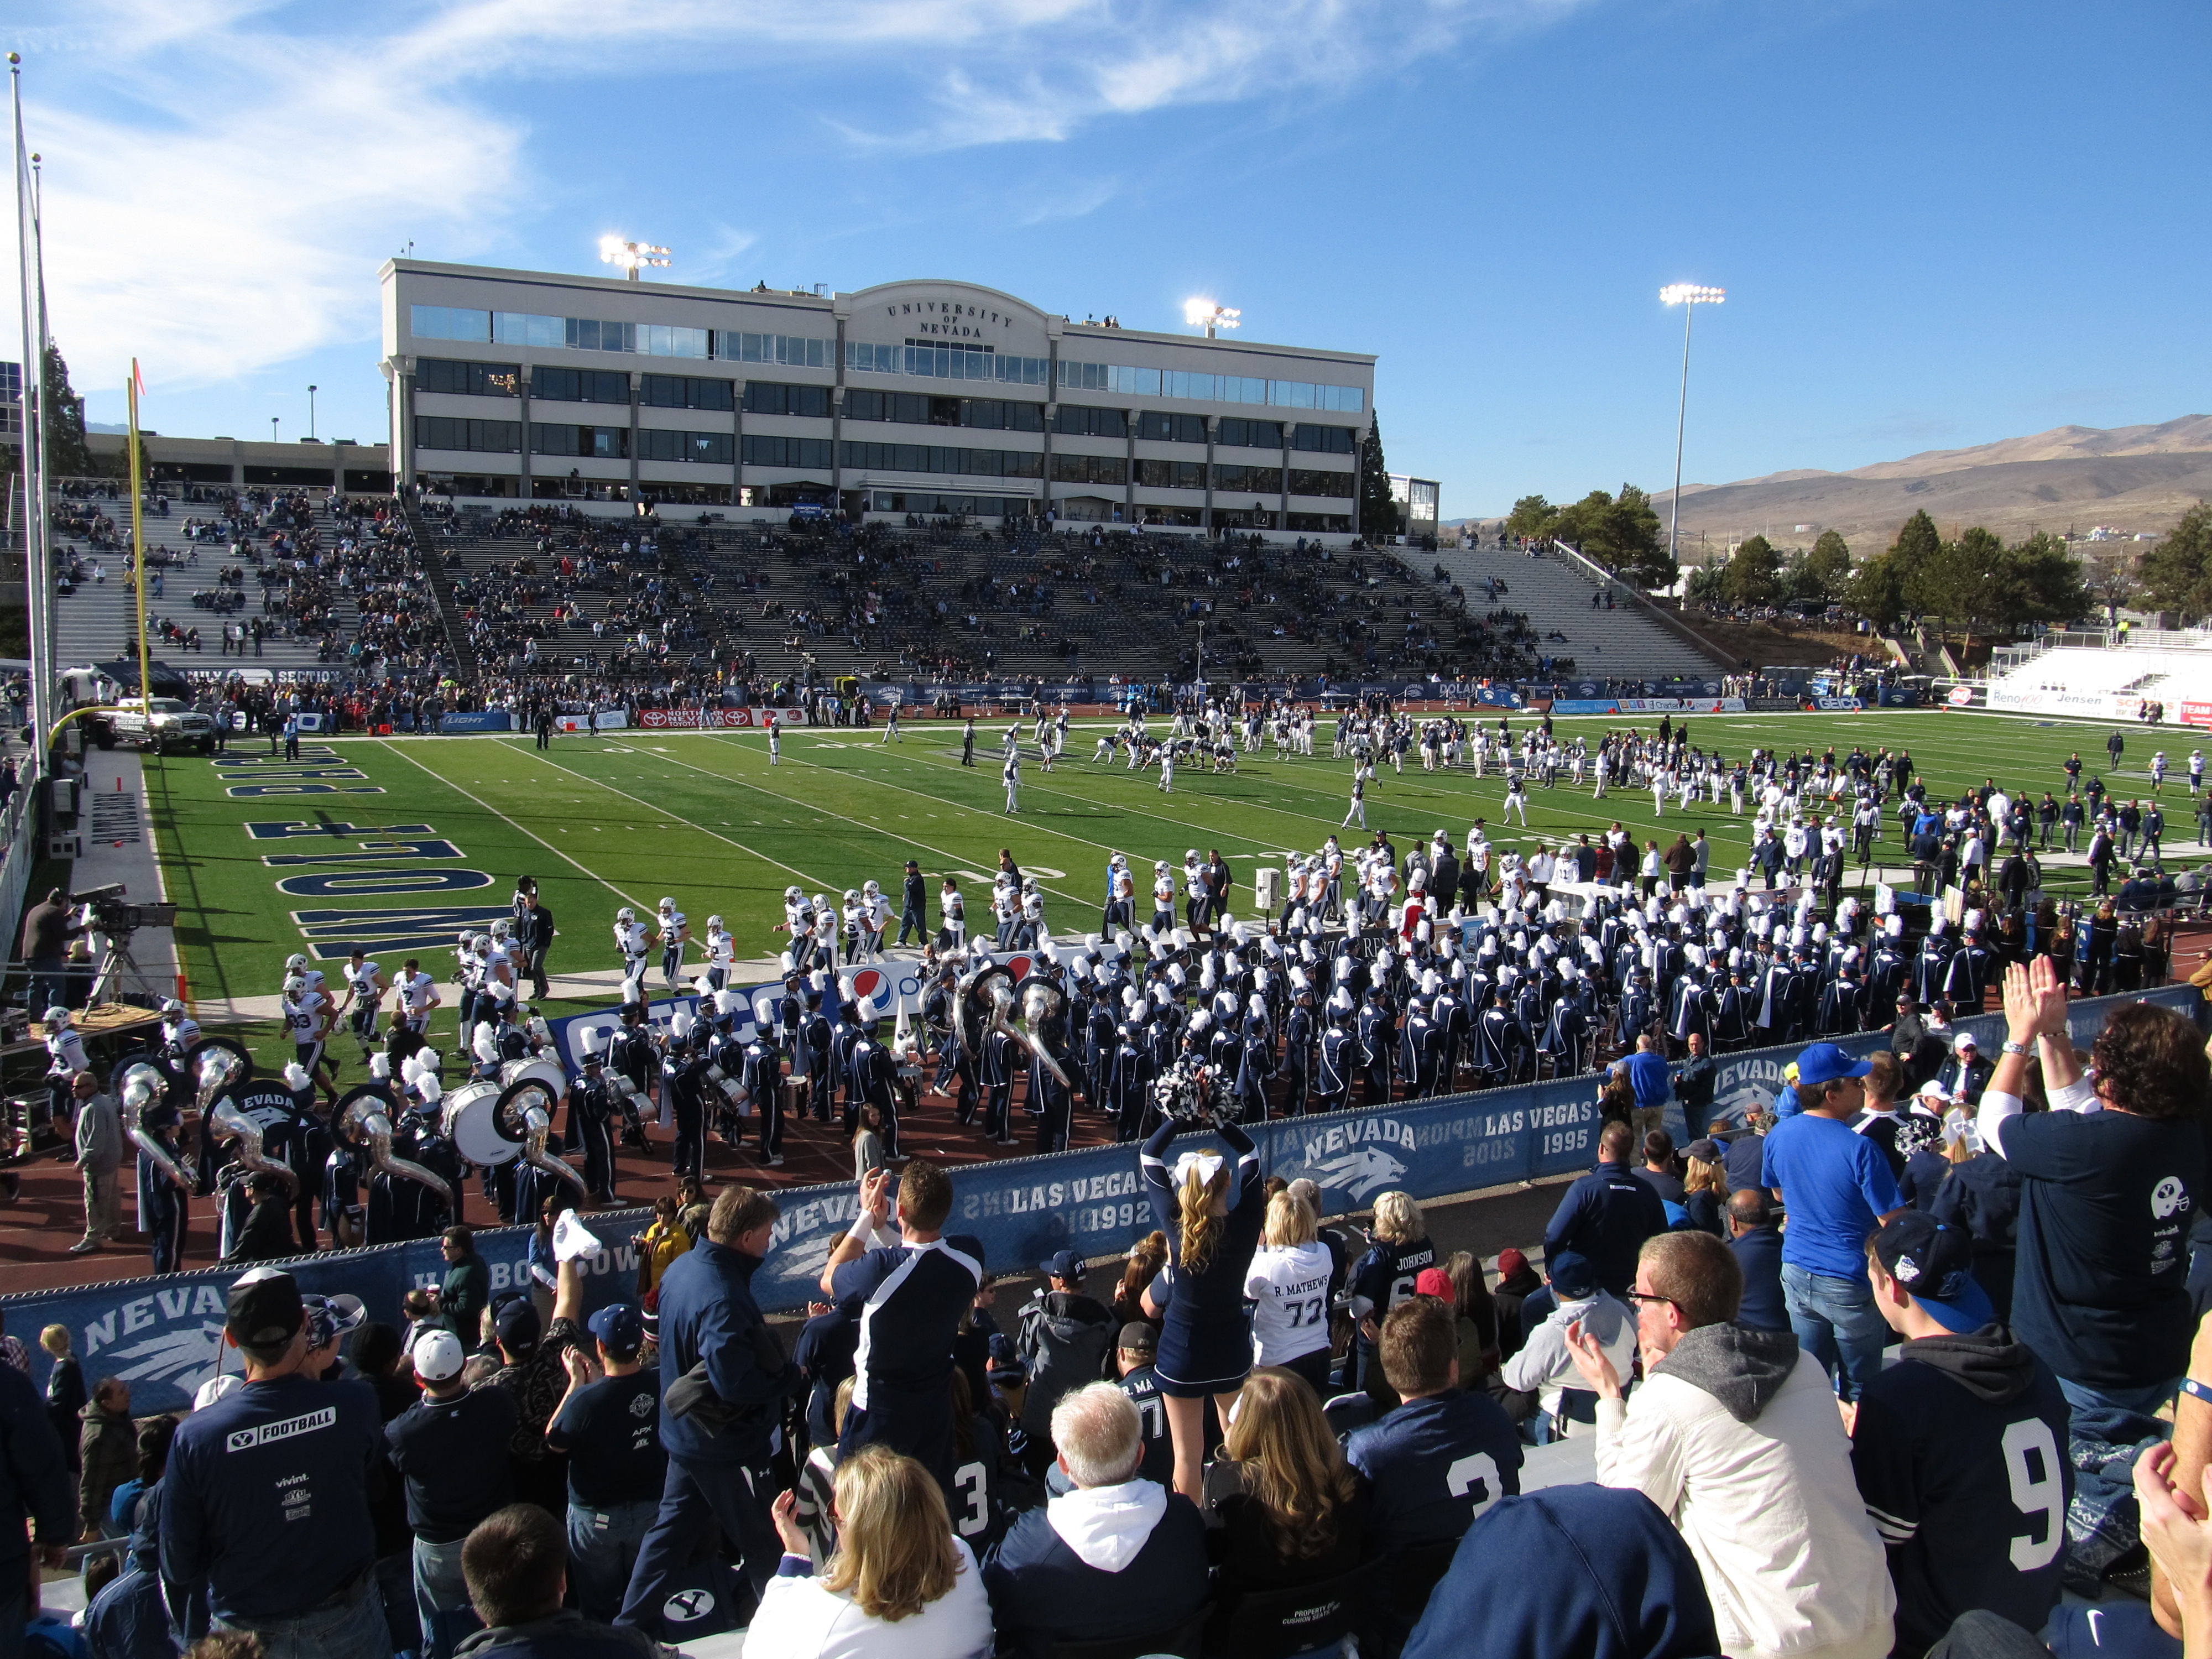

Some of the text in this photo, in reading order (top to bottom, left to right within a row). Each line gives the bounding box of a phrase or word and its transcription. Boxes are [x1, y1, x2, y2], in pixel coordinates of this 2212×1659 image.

[888, 302, 1011, 327] UNIVERSITY
[943, 316, 958, 324] OF
[920, 322, 981, 337] NEVADA
[279, 671, 340, 683] SECTION
[878, 687, 904, 695] NEVADA
[1439, 684, 1478, 695] DOLAN
[2057, 694, 2102, 705] Jensen
[1818, 698, 1862, 709] GEICO
[243, 1094, 295, 1109] EVADA
[1485, 1101, 1592, 1137] LAS VEGAS
[1304, 1118, 1417, 1168] NEVADA
[1543, 1129, 1588, 1155] 1995
[1012, 1183, 1063, 1214] LAS
[1072, 1171, 1149, 1203] VEGAS
[1092, 1201, 1151, 1232] 1992
[1396, 1249, 1433, 1271] JOHNSON
[1274, 1275, 1329, 1298] R. MATHEWS
[85, 1285, 227, 1358] NEVA
[1284, 1296, 1324, 1328] 72
[263, 1411, 332, 1440] FOOTBALL
[632, 1425, 653, 1437] APX
[275, 1473, 310, 1488] vivint.
[954, 1461, 989, 1536] 3
[2001, 1417, 2064, 1572] 9
[1282, 1615, 1311, 1625] CUSHION
[1295, 1605, 1326, 1618] PROPERTY
